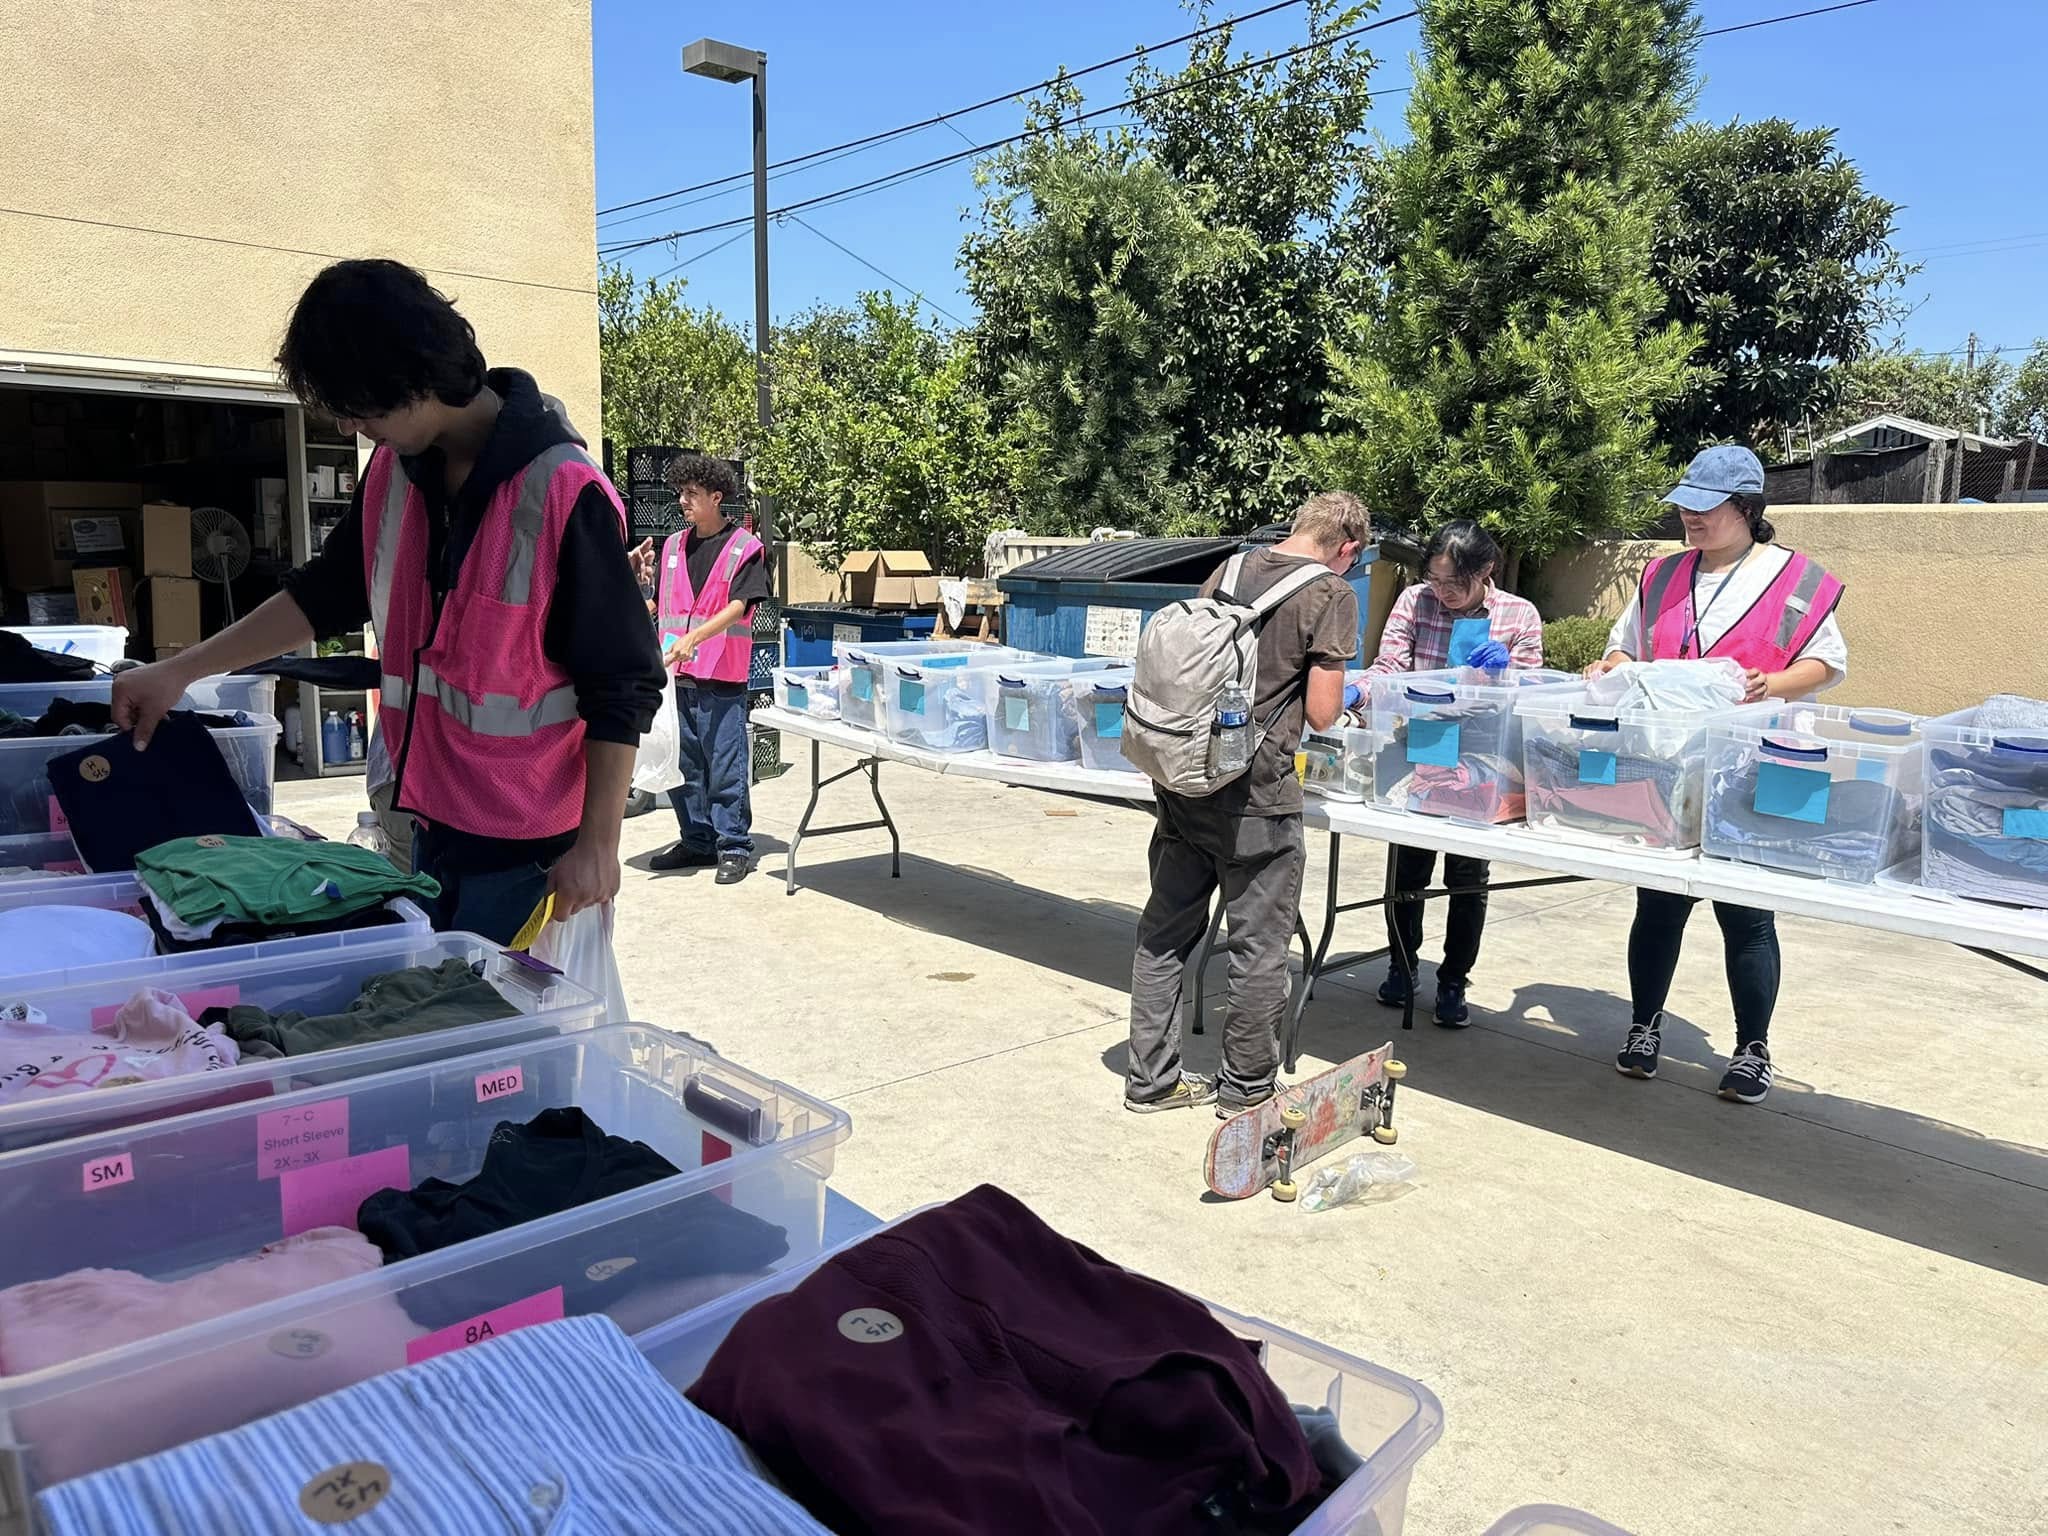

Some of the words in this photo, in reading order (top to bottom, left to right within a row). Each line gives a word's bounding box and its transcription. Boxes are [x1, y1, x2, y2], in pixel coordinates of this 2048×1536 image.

[482, 1075, 517, 1097] MED
[282, 1114, 291, 1126] 7
[303, 1110, 315, 1122] C
[263, 1135, 300, 1151] Short
[302, 1126, 345, 1143] Sleeve
[273, 1156, 291, 1170] 2X
[303, 1150, 321, 1163] 3X
[91, 1162, 124, 1183] SM
[465, 1320, 495, 1344] 8A
